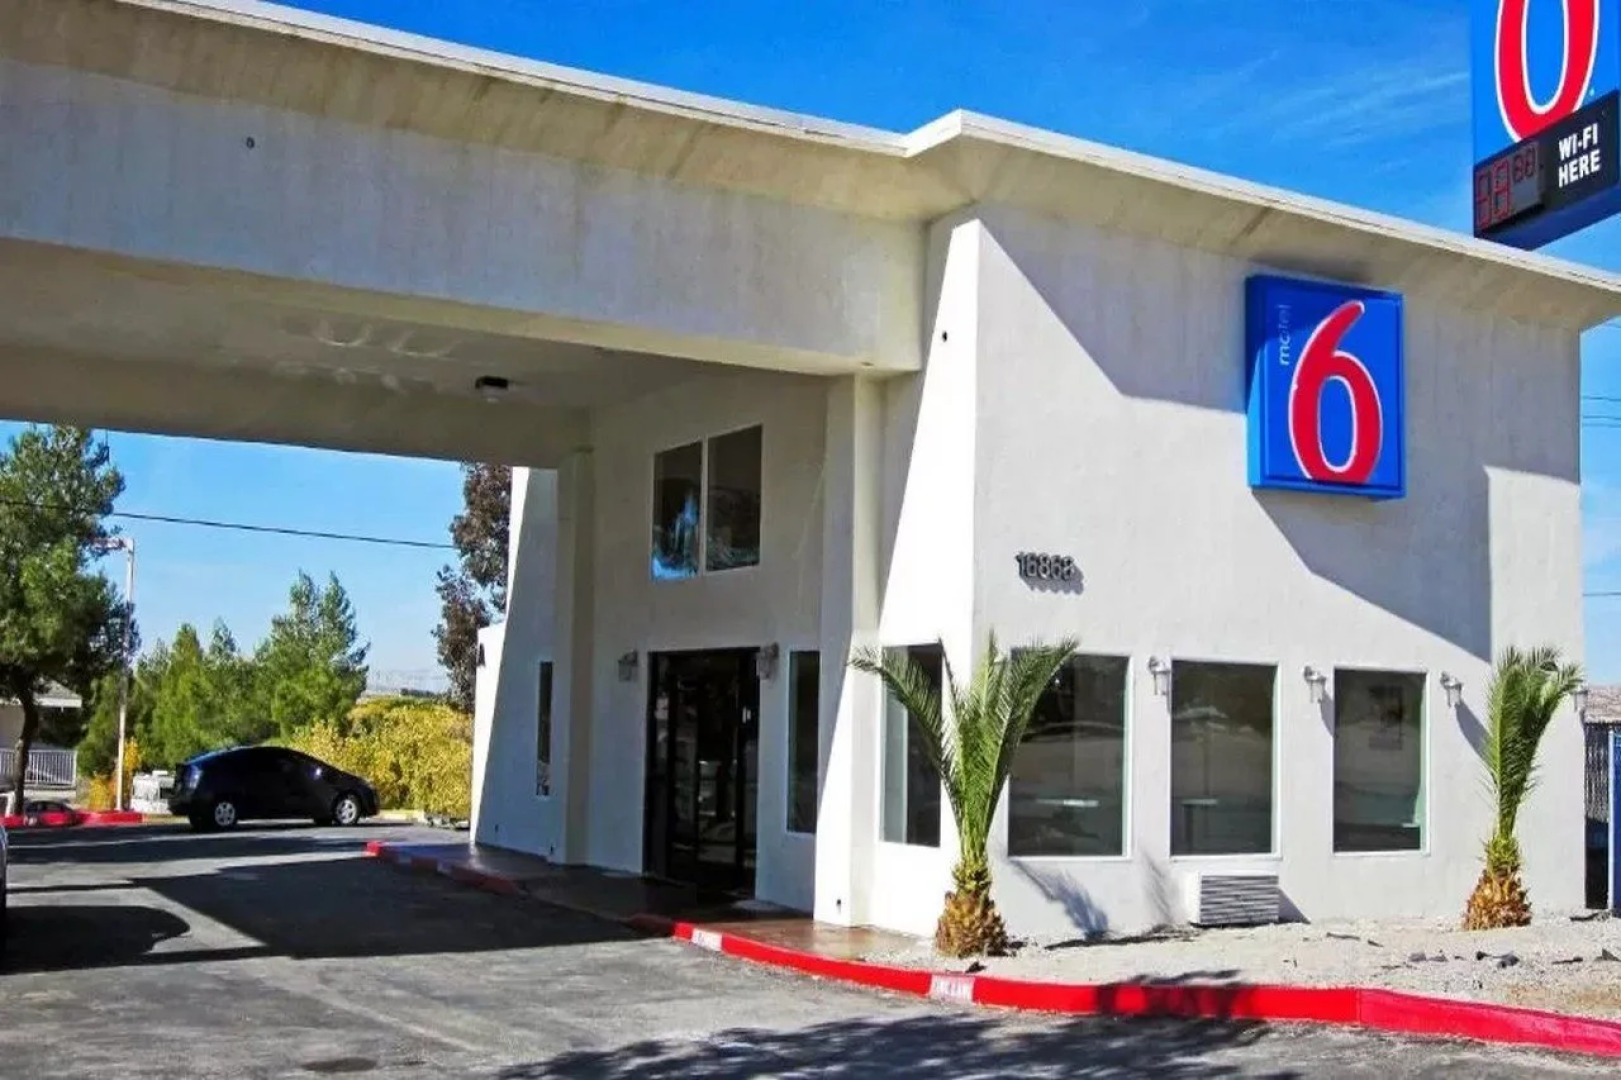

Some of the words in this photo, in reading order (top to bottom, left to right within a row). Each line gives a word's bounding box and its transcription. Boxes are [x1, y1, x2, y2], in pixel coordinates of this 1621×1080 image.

[1558, 122, 1599, 161] WI-FI
[1558, 149, 1601, 188] HERE
[1289, 300, 1383, 484] 6
